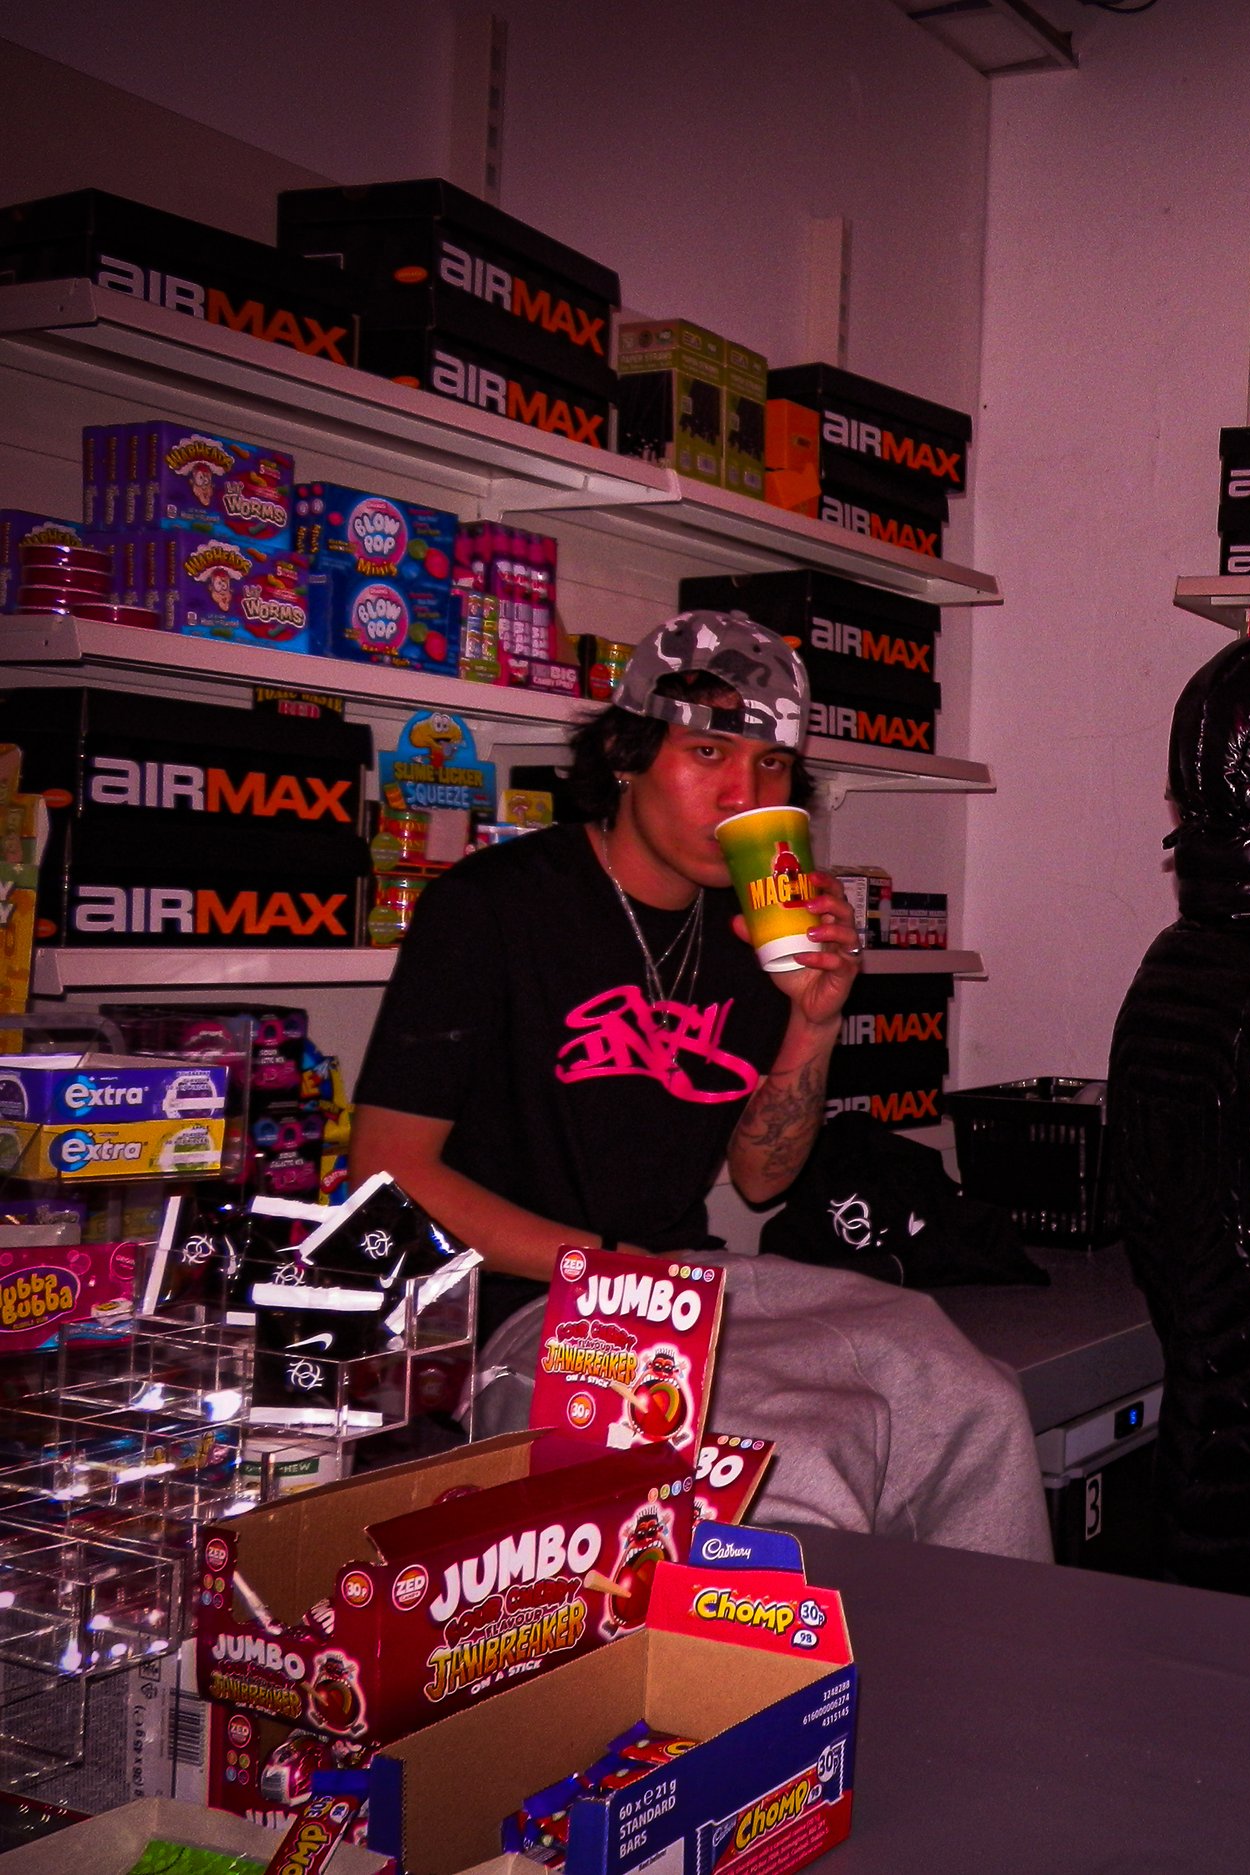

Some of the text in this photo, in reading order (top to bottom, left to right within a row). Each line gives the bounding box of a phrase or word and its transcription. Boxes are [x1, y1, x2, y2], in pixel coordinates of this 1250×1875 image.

[223, 494, 287, 529] WORMS
[354, 512, 400, 537] BLOW
[364, 534, 396, 554] POP
[242, 598, 306, 628] WORMS
[357, 598, 402, 623] BLOW
[367, 620, 398, 640] POP
[407, 780, 471, 810] SQUEEZE
[65, 1083, 143, 1109] extra
[61, 1137, 142, 1163] extra
[563, 1258, 585, 1271] ZED
[577, 1273, 702, 1332] JUMBO
[543, 1341, 638, 1385] JAWBREAKER
[208, 1548, 227, 1559] ZED
[702, 1538, 752, 1560] Cadbury
[396, 1577, 426, 1595] ZED
[429, 1522, 602, 1622] JUMBO
[484, 1608, 543, 1639] FLAVOUR
[802, 1604, 824, 1626] 30p
[424, 1600, 586, 1702] JAWBREAKER
[800, 1632, 812, 1643] 98
[211, 1633, 306, 1680] JUMBO
[471, 1658, 543, 1696] ON A STICK
[209, 1671, 302, 1719] JAWBREAKER
[619, 1803, 633, 1821] 60
[635, 1798, 642, 1812] x
[655, 1781, 667, 1799] 21
[669, 1778, 677, 1795] g
[619, 1794, 677, 1840] STANDARD
[619, 1829, 648, 1860] BARS
